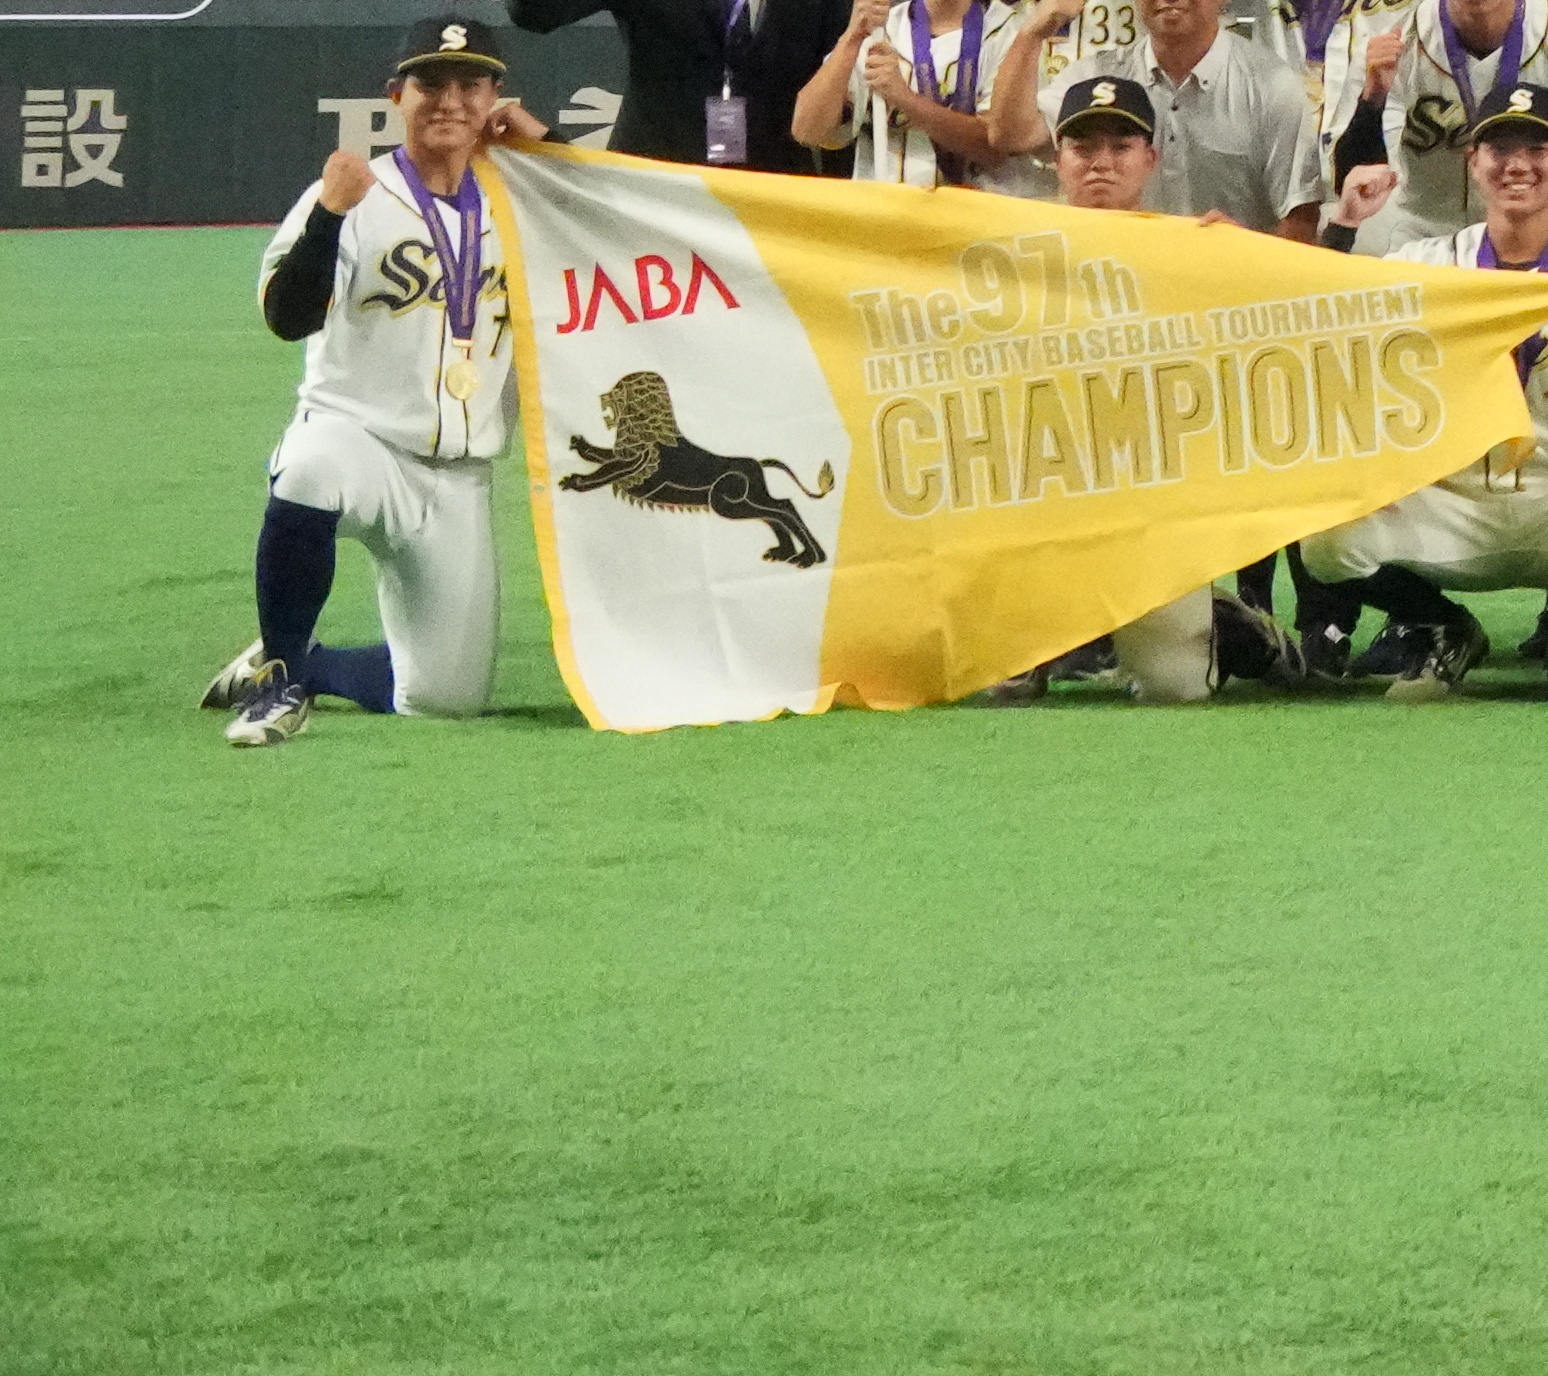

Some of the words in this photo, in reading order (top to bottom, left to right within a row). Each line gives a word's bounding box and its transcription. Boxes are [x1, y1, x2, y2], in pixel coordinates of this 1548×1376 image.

[1089, 3, 1137, 46] 33
[20, 89, 128, 188] 設
[556, 249, 742, 335] JABA
[849, 286, 957, 357] The
[957, 231, 1140, 338] 97th
[866, 345, 957, 394] INTER
[961, 338, 1034, 380] CITY
[1043, 315, 1201, 371] BASEBALL
[1210, 282, 1424, 344] TOURNAMENT
[868, 327, 1446, 520] CHAMPIONS
